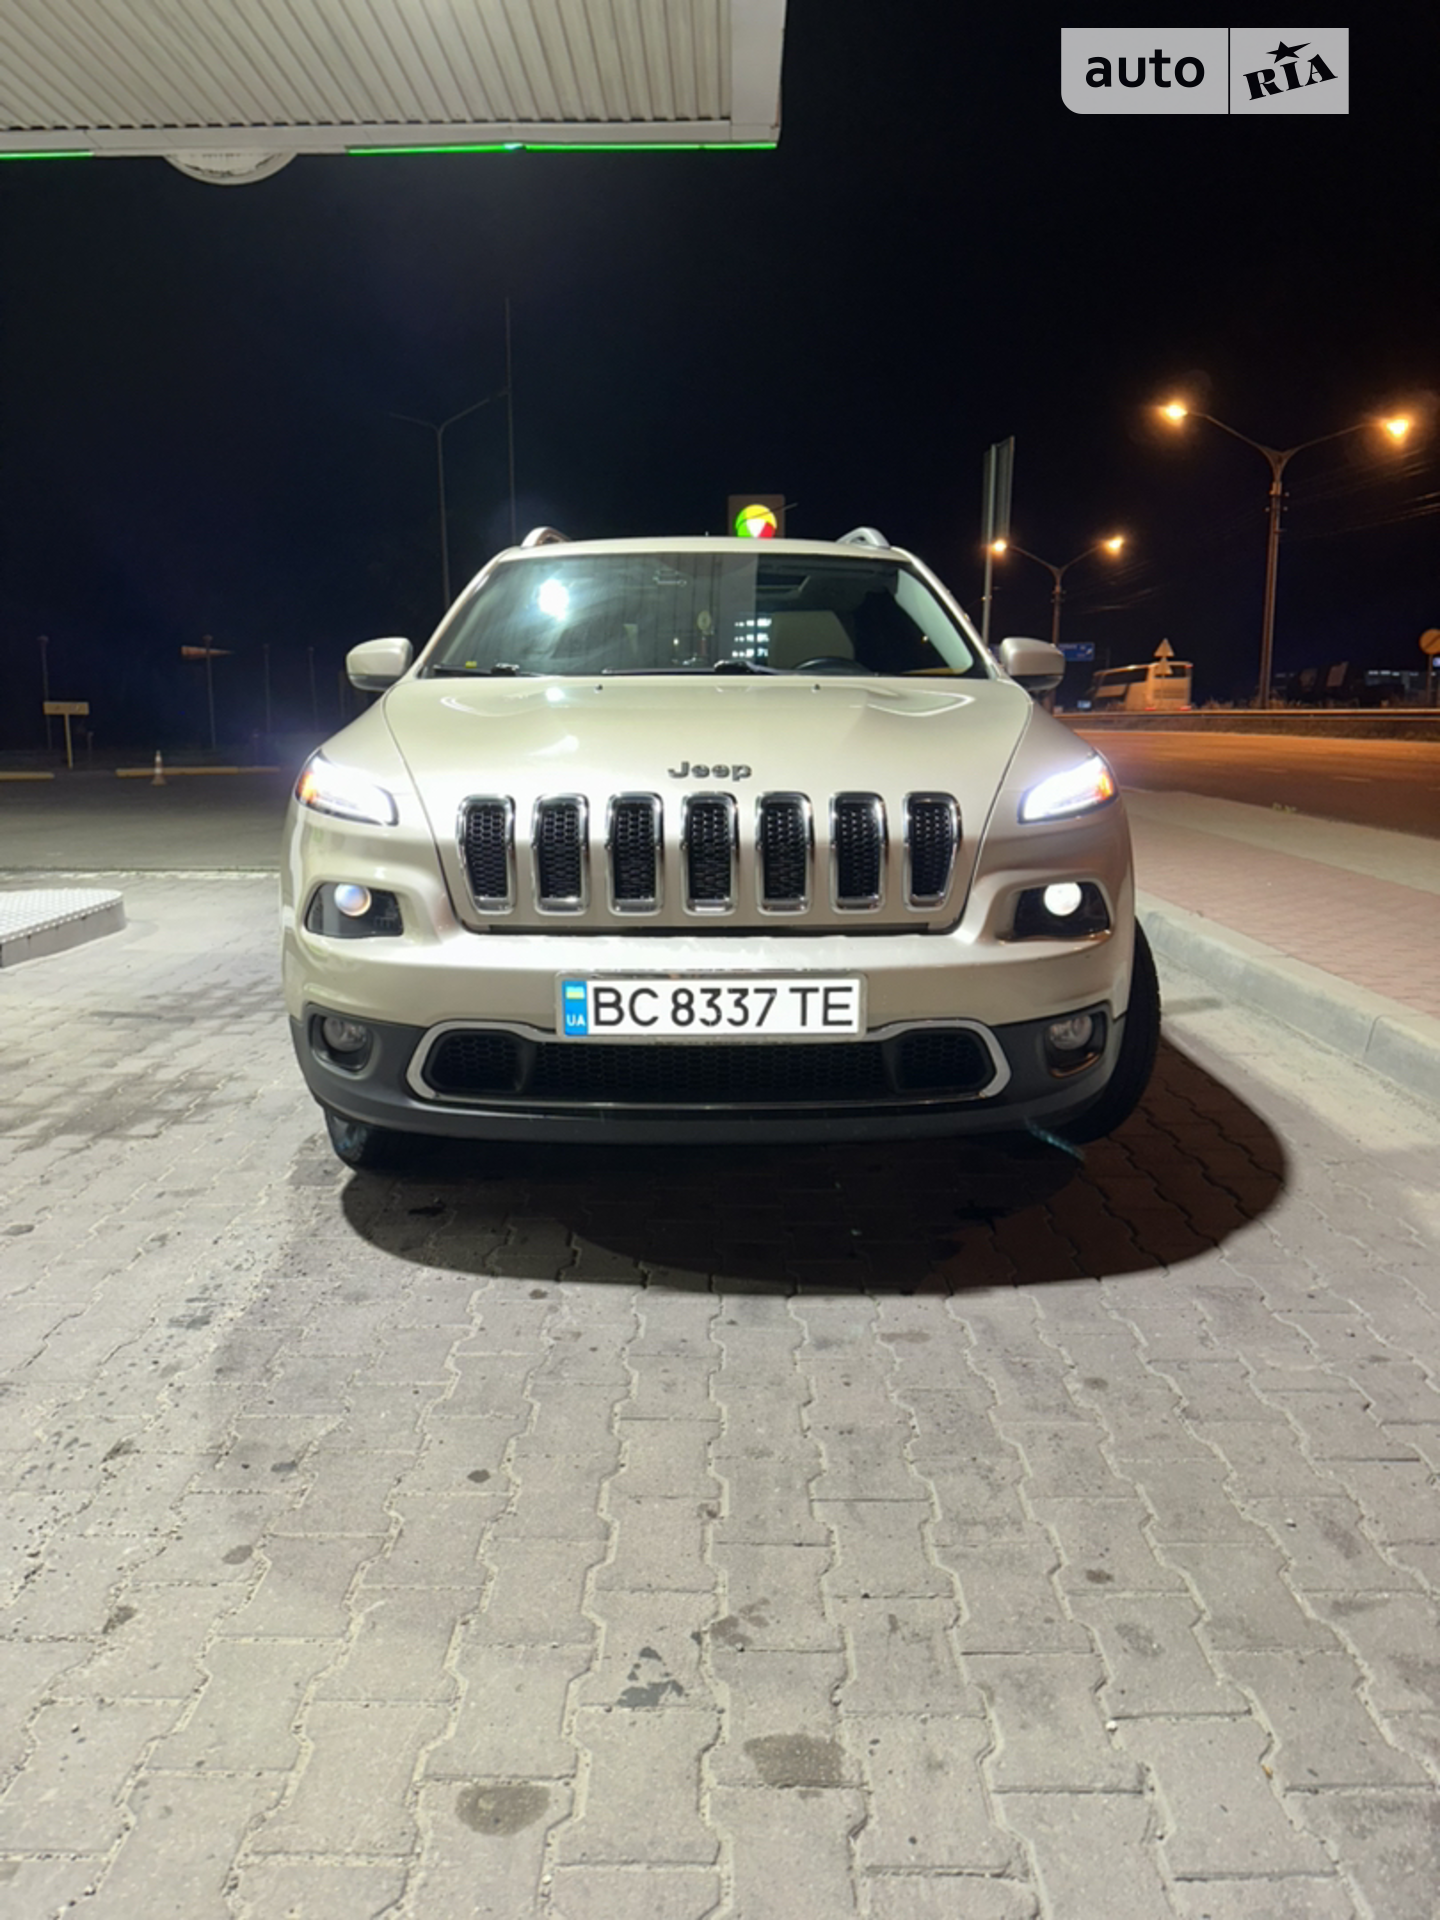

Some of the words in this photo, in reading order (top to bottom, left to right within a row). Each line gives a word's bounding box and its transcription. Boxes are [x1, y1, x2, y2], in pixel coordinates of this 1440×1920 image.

[668, 761, 751, 781] Jeep
[593, 987, 658, 1027] BC
[671, 987, 777, 1027] 8337
[789, 986, 853, 1027] TE
[566, 1014, 585, 1027] UA
